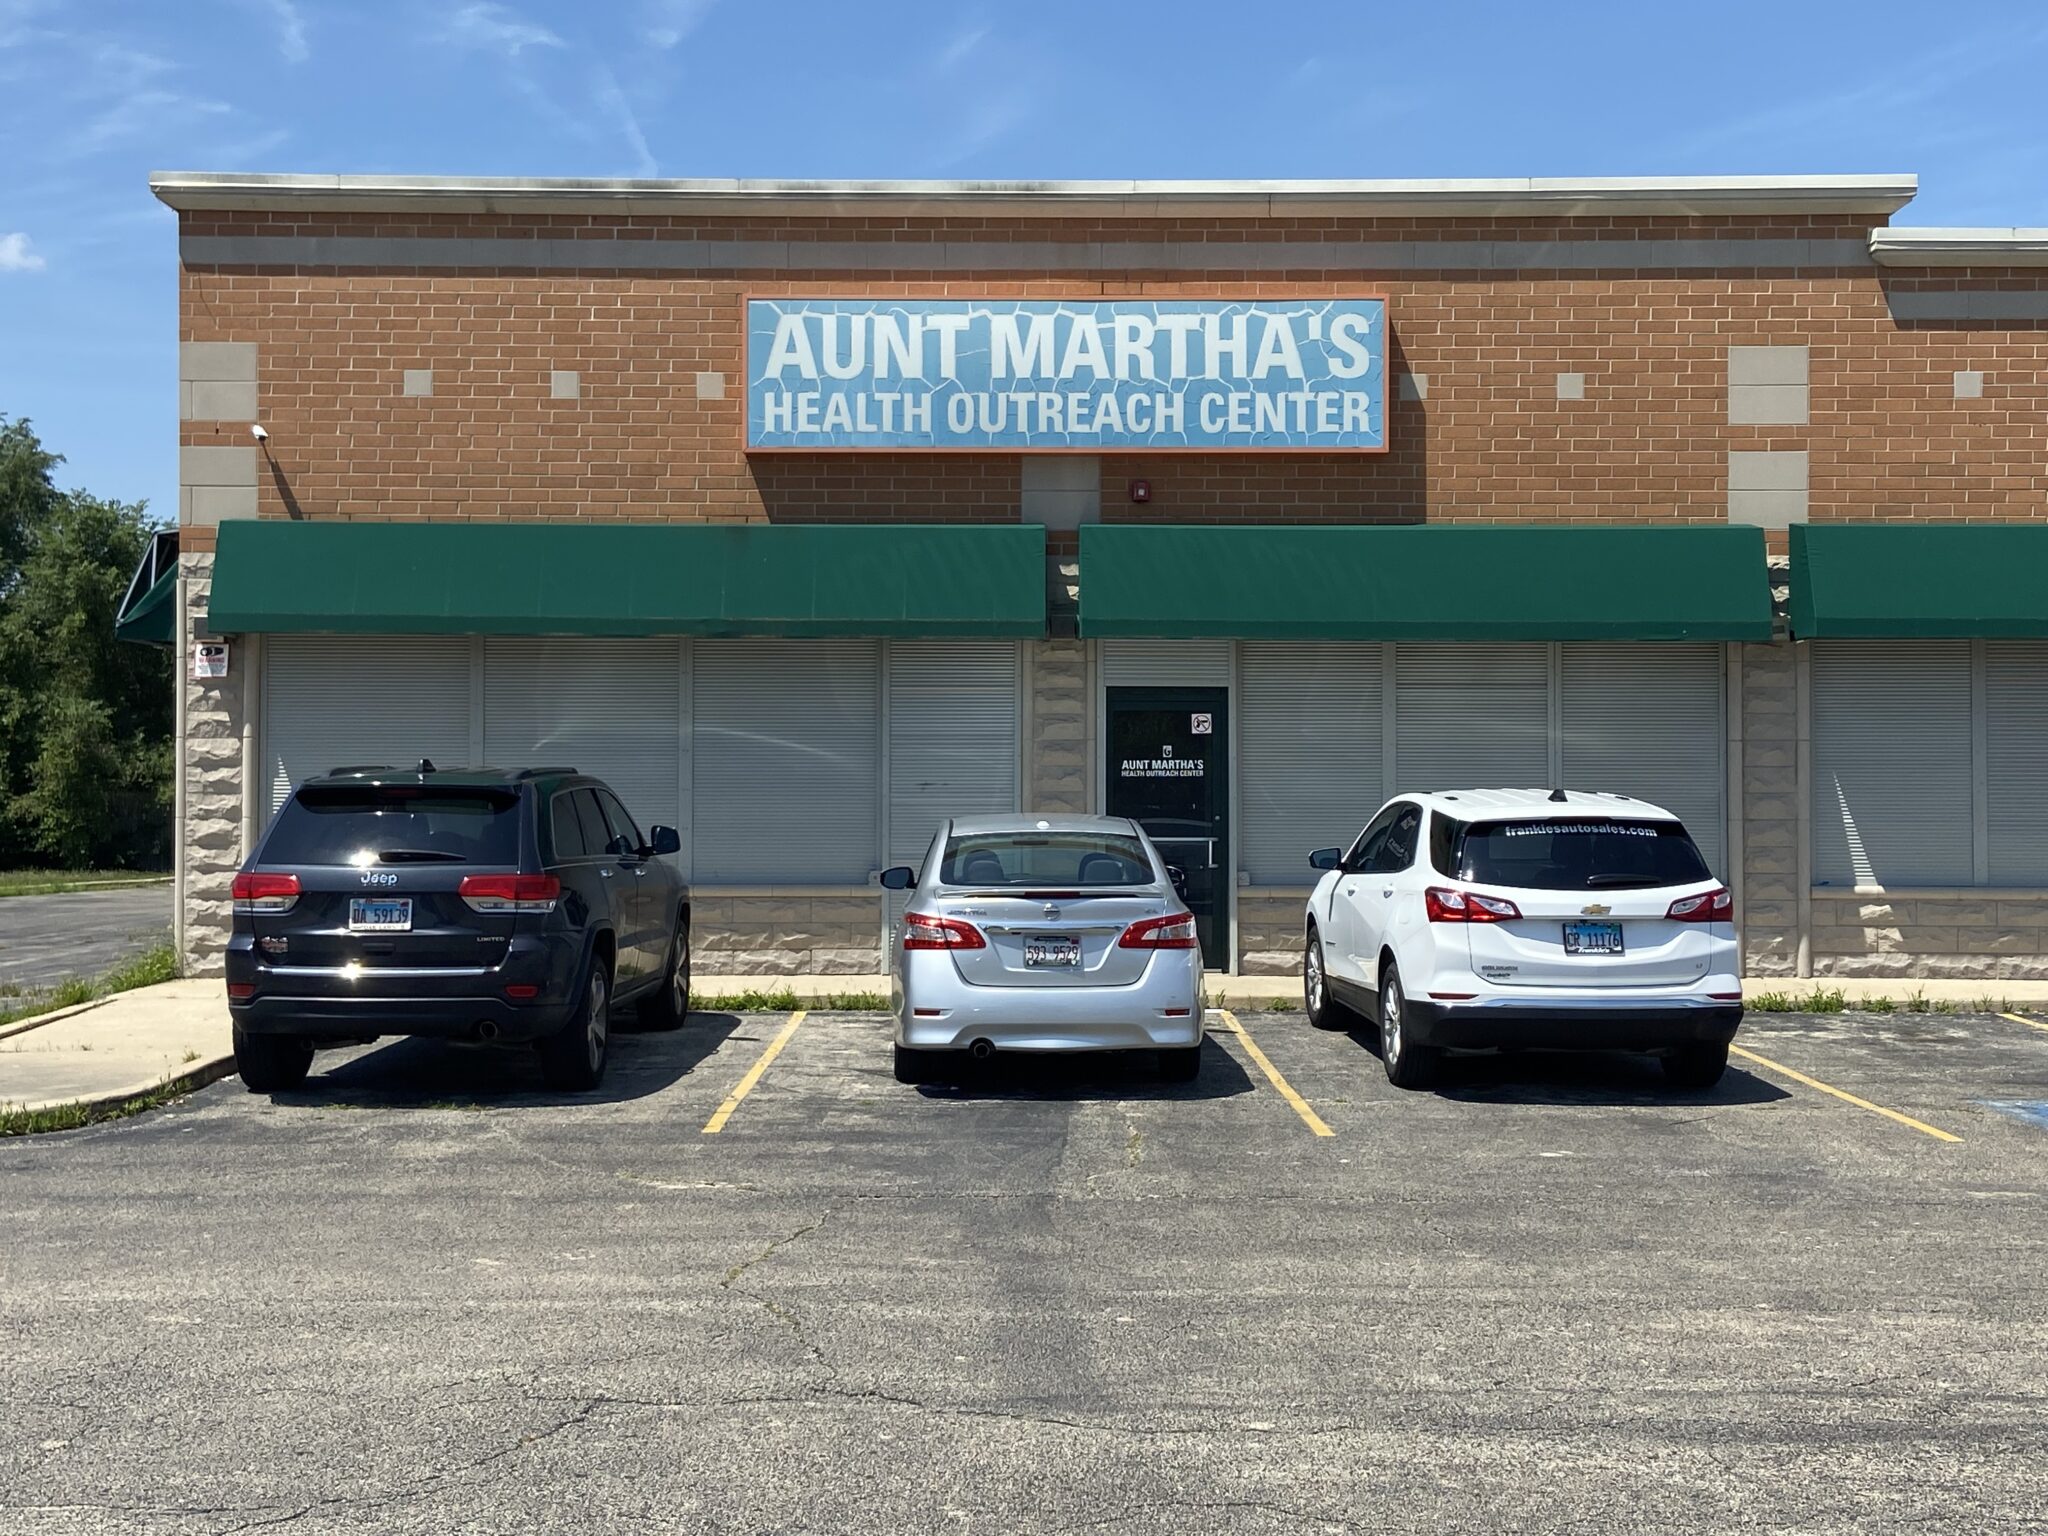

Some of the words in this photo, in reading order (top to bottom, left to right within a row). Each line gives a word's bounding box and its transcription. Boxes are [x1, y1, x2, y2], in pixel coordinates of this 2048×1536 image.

[764, 312, 971, 381] AUNT
[989, 312, 1372, 381] MARTHA'S
[764, 391, 932, 434] HEALTH
[947, 391, 1184, 434] OUTREACH
[1199, 391, 1370, 434] CENTER
[1121, 760, 1150, 770] AUNT
[1151, 760, 1204, 770] MARTHA'S
[1505, 823, 1658, 837] frankiesautosales.com
[360, 870, 398, 886] Jeep
[1567, 932, 1581, 947] CR
[1587, 932, 1620, 947] 11176
[1027, 945, 1047, 961] 593
